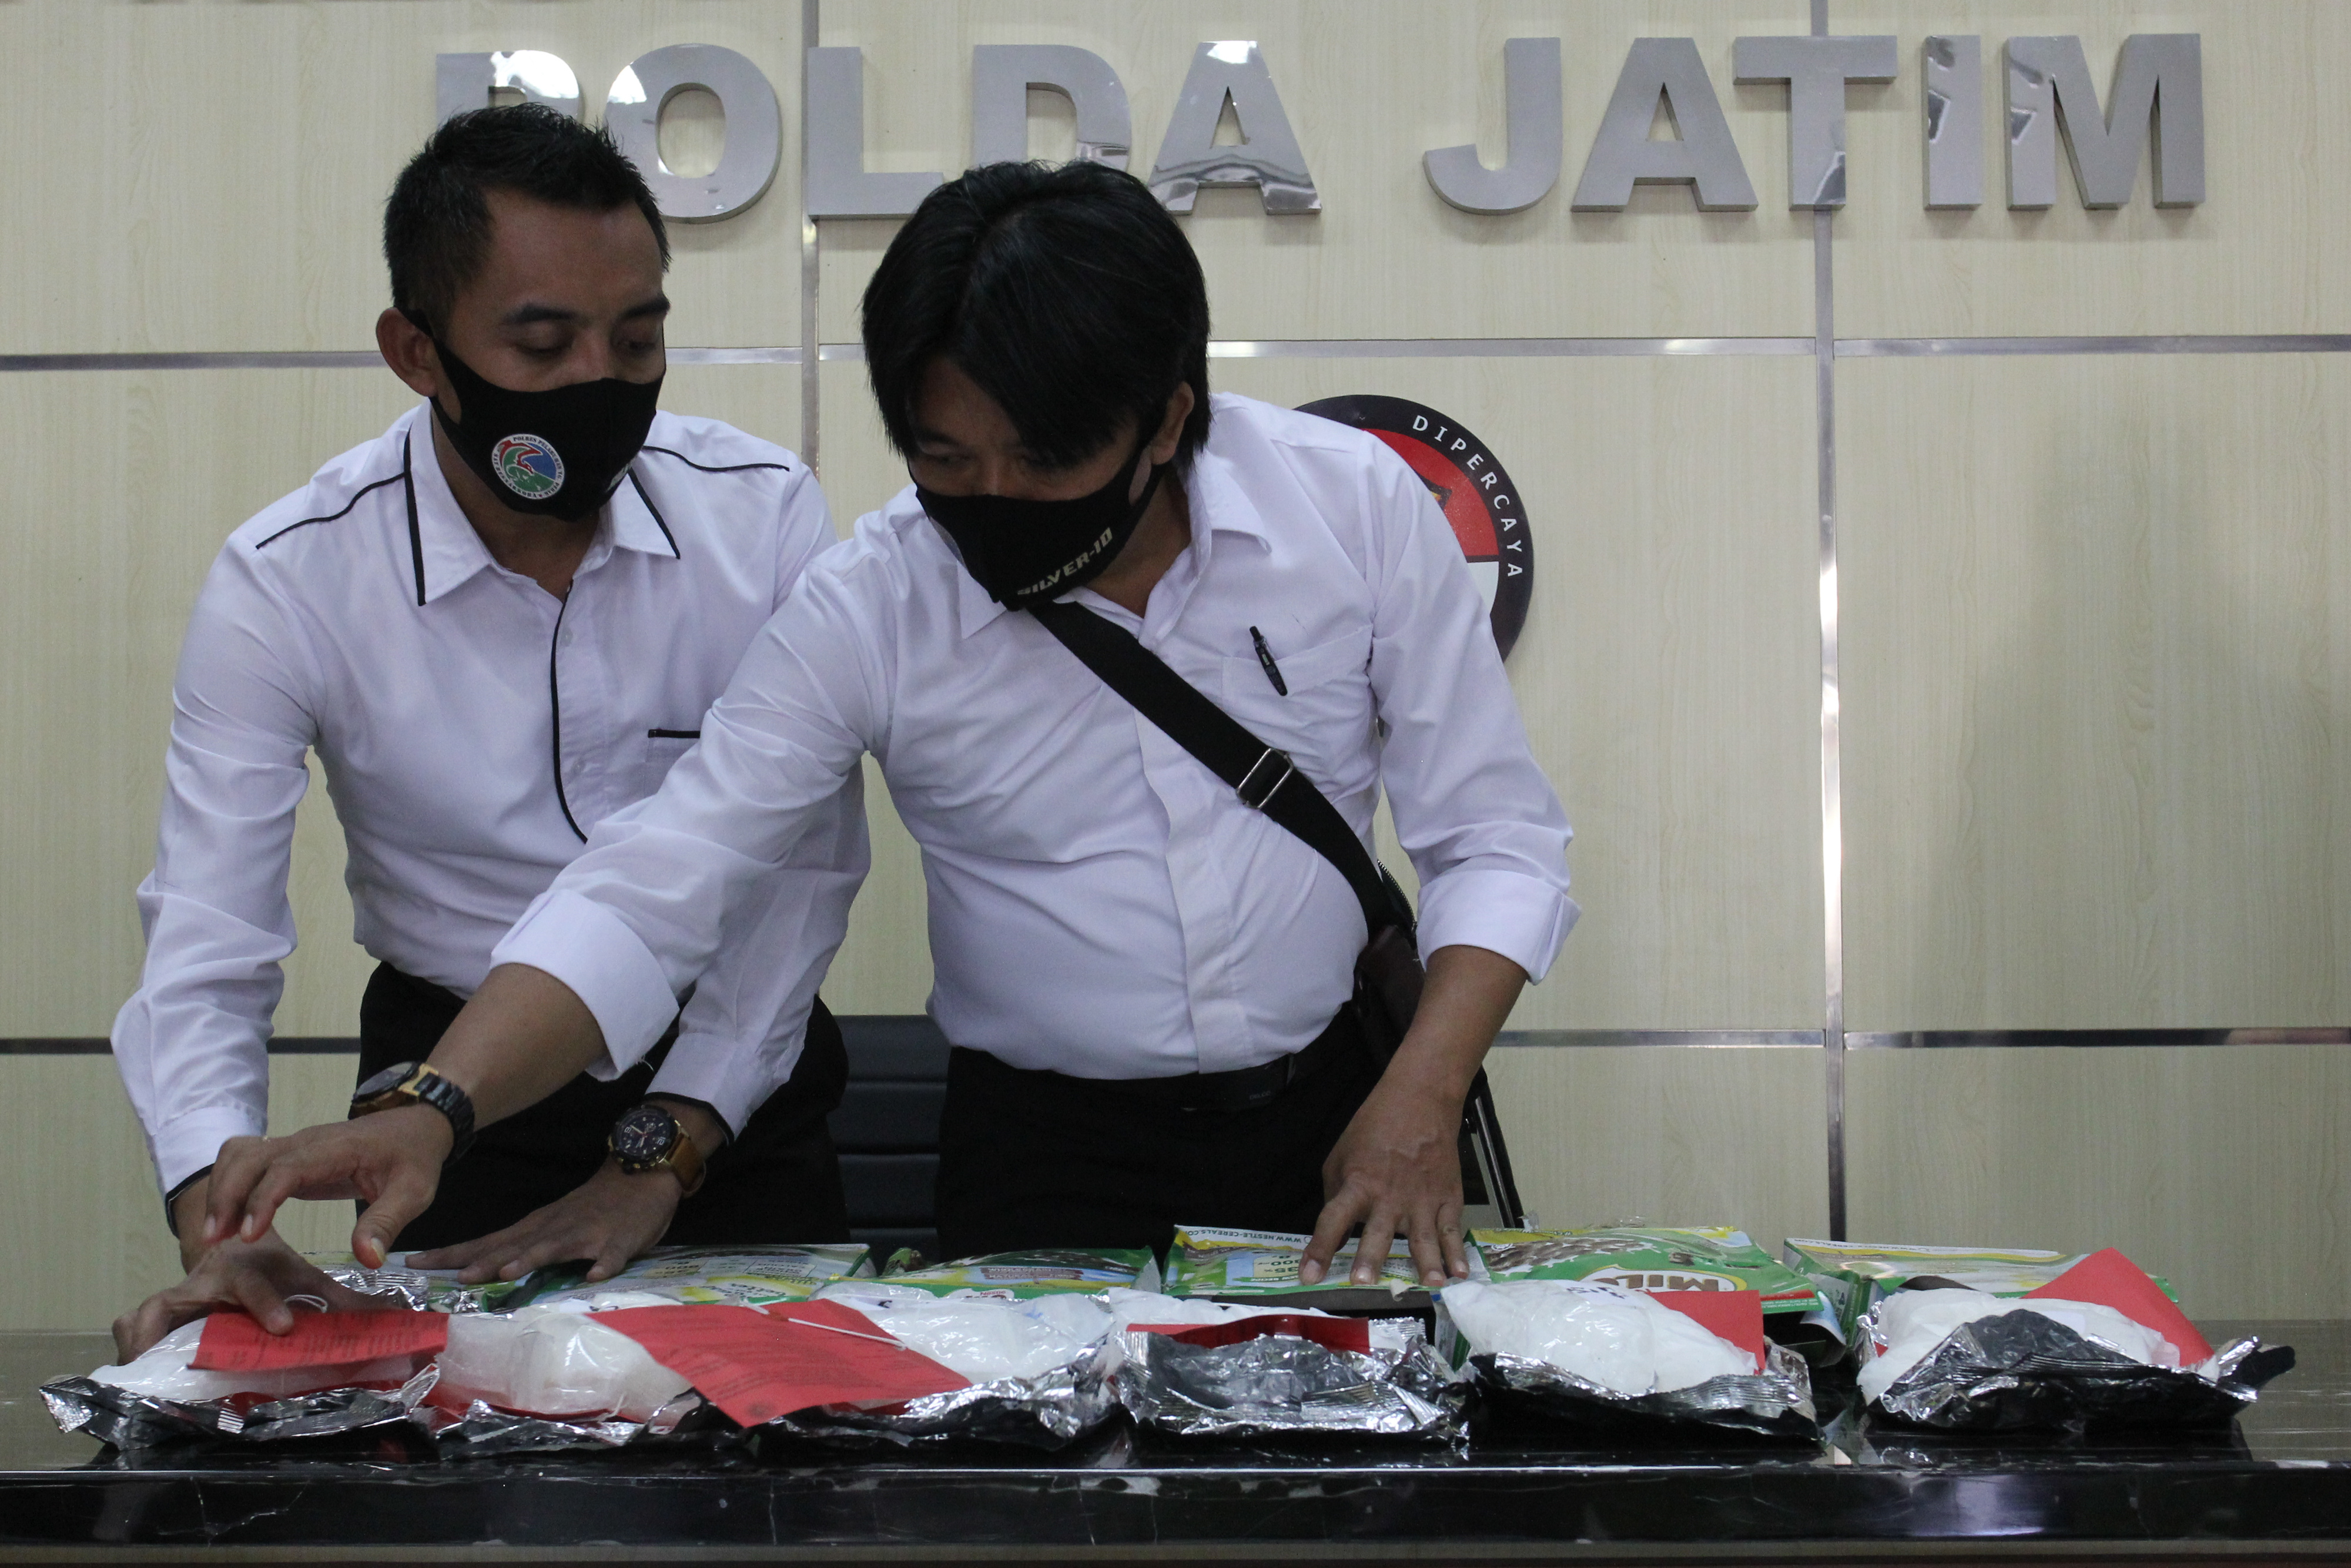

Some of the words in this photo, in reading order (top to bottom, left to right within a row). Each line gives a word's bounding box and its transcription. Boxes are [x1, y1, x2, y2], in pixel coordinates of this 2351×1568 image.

[1423, 33, 2206, 215] JATIM
[1412, 415, 1523, 577] DIPERCAYA
[1017, 527, 1113, 595] SILVER-10
[1185, 1229, 1301, 1243] WWW.NESTLE-CEREALS.CO
